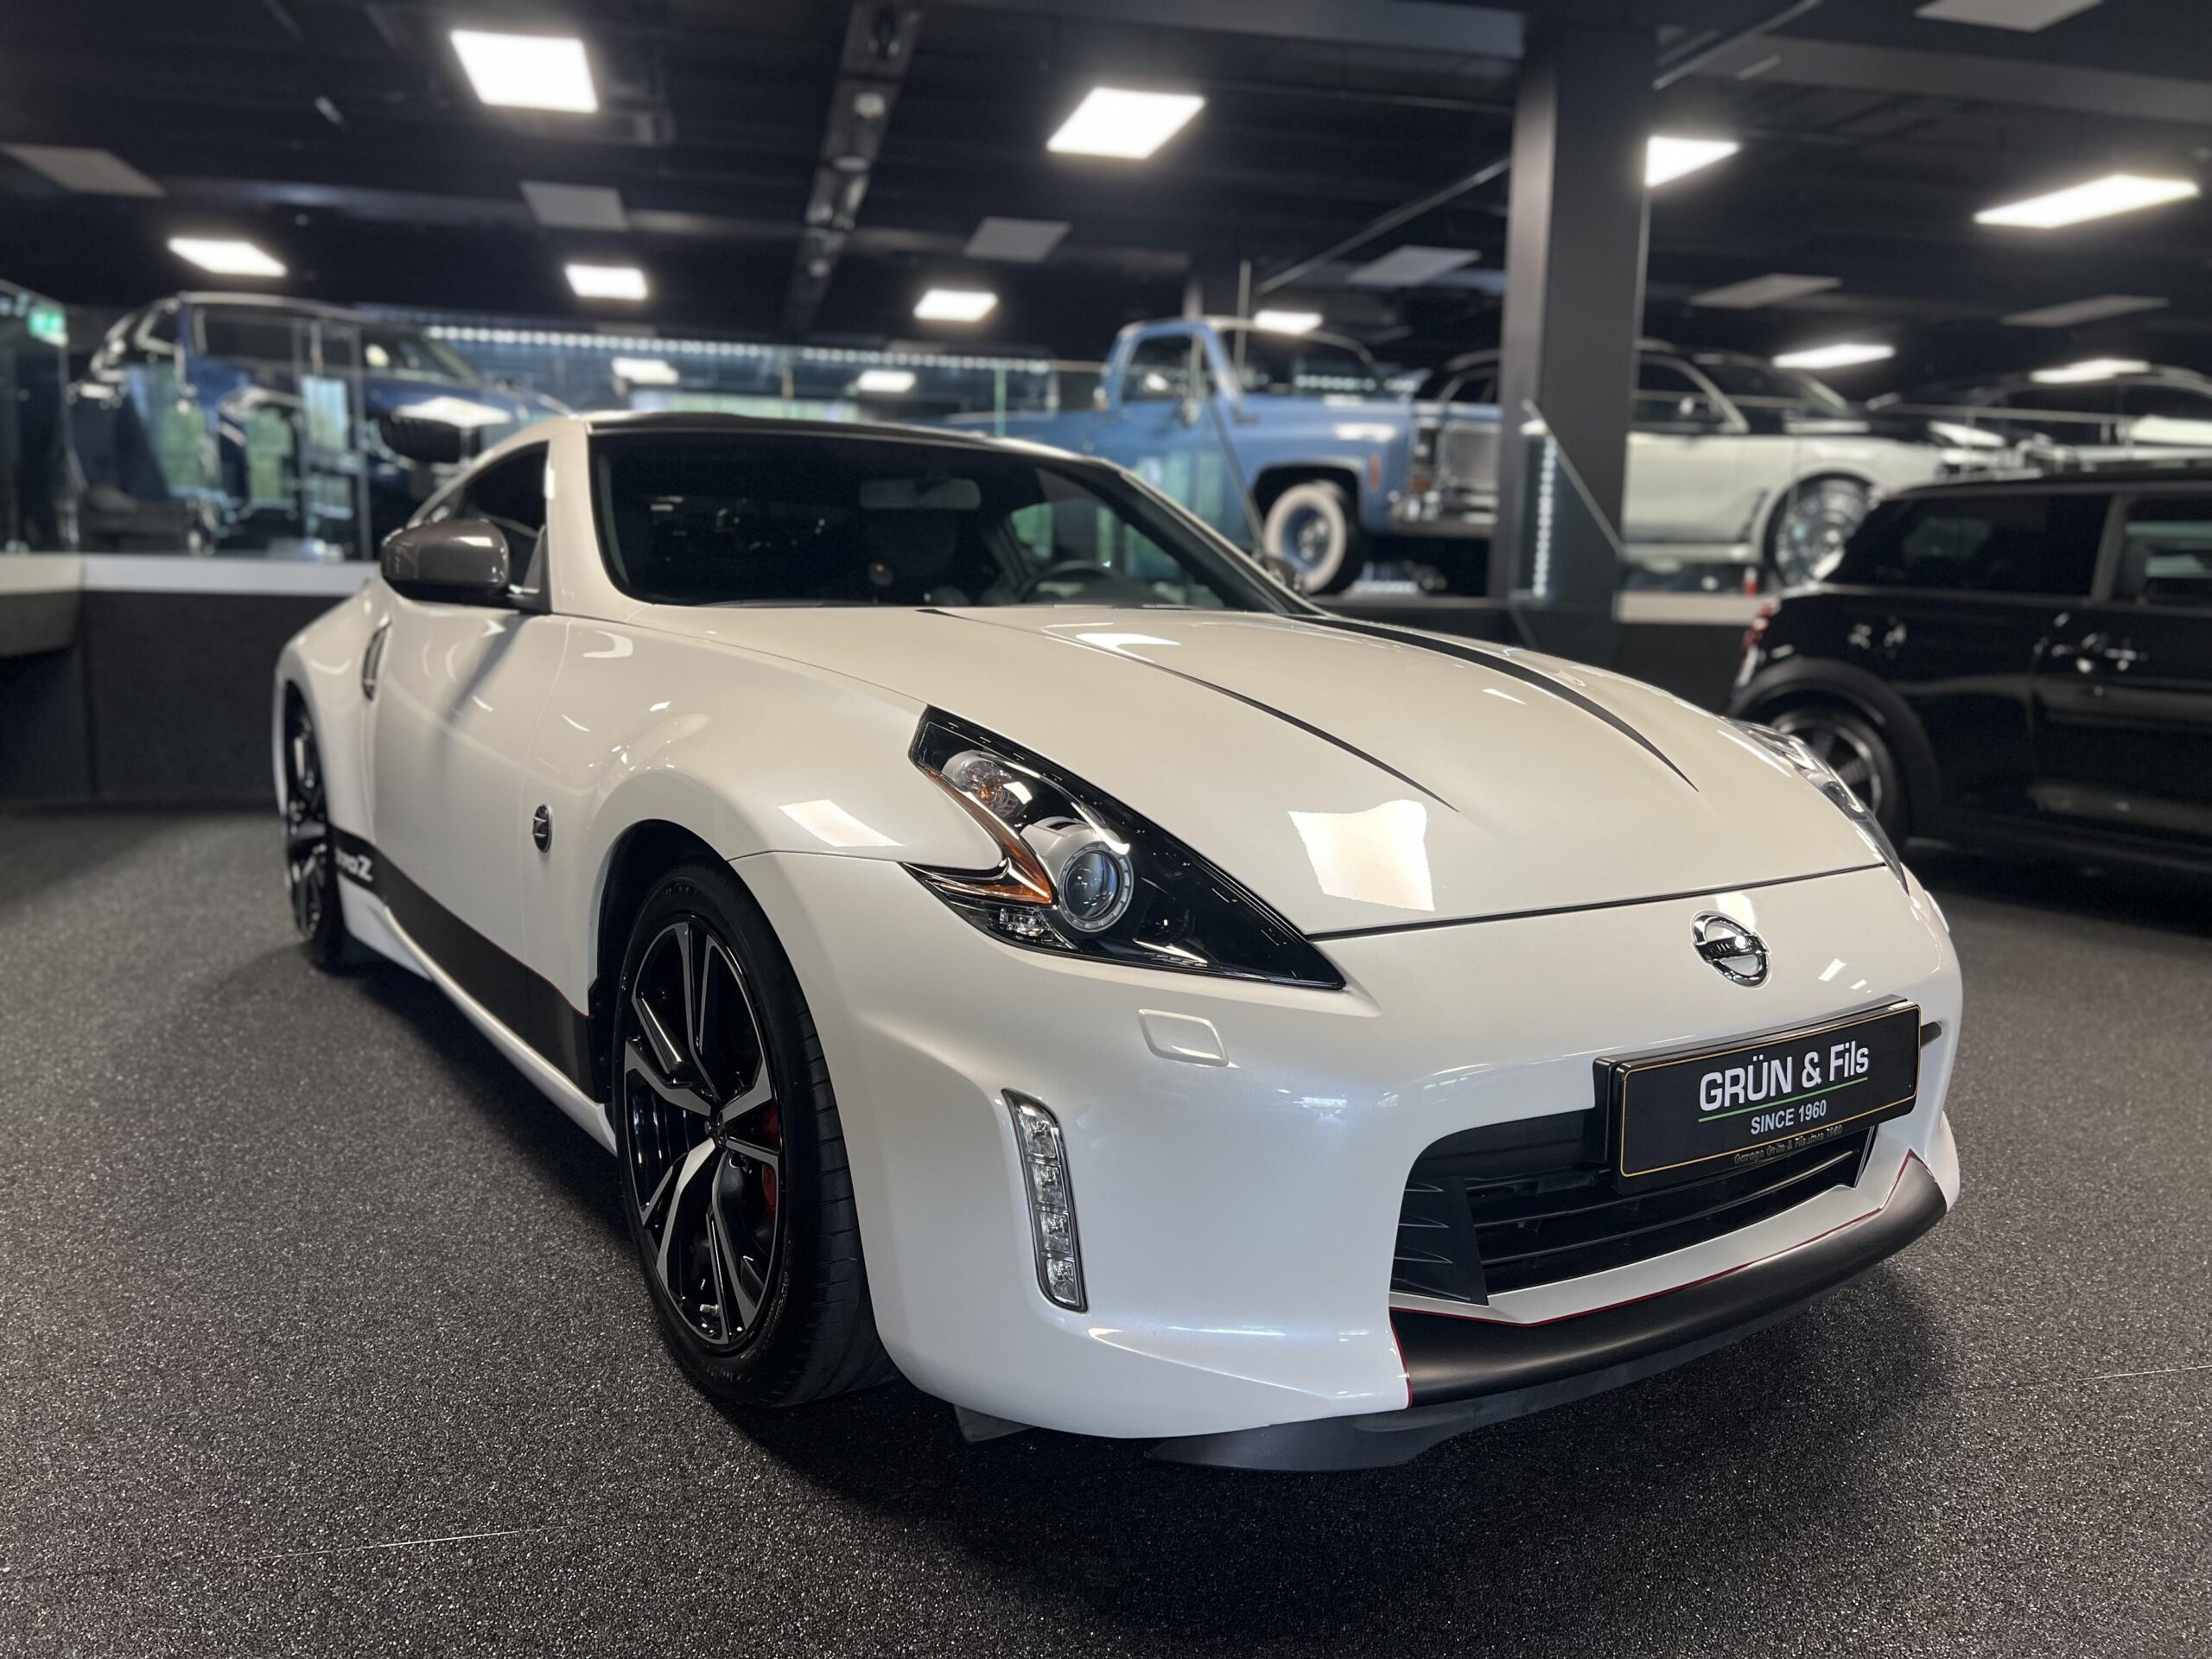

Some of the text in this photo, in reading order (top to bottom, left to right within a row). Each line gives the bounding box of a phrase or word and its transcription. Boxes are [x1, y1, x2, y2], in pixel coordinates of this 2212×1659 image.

[1700, 1040, 1869, 1112] GRÜN & Fils
[1750, 1099, 1827, 1135] SINCE 1960
[1733, 1149, 1764, 1164] Garage
[1787, 1140, 1794, 1150] &
[1826, 1124, 1843, 1138] 1960
